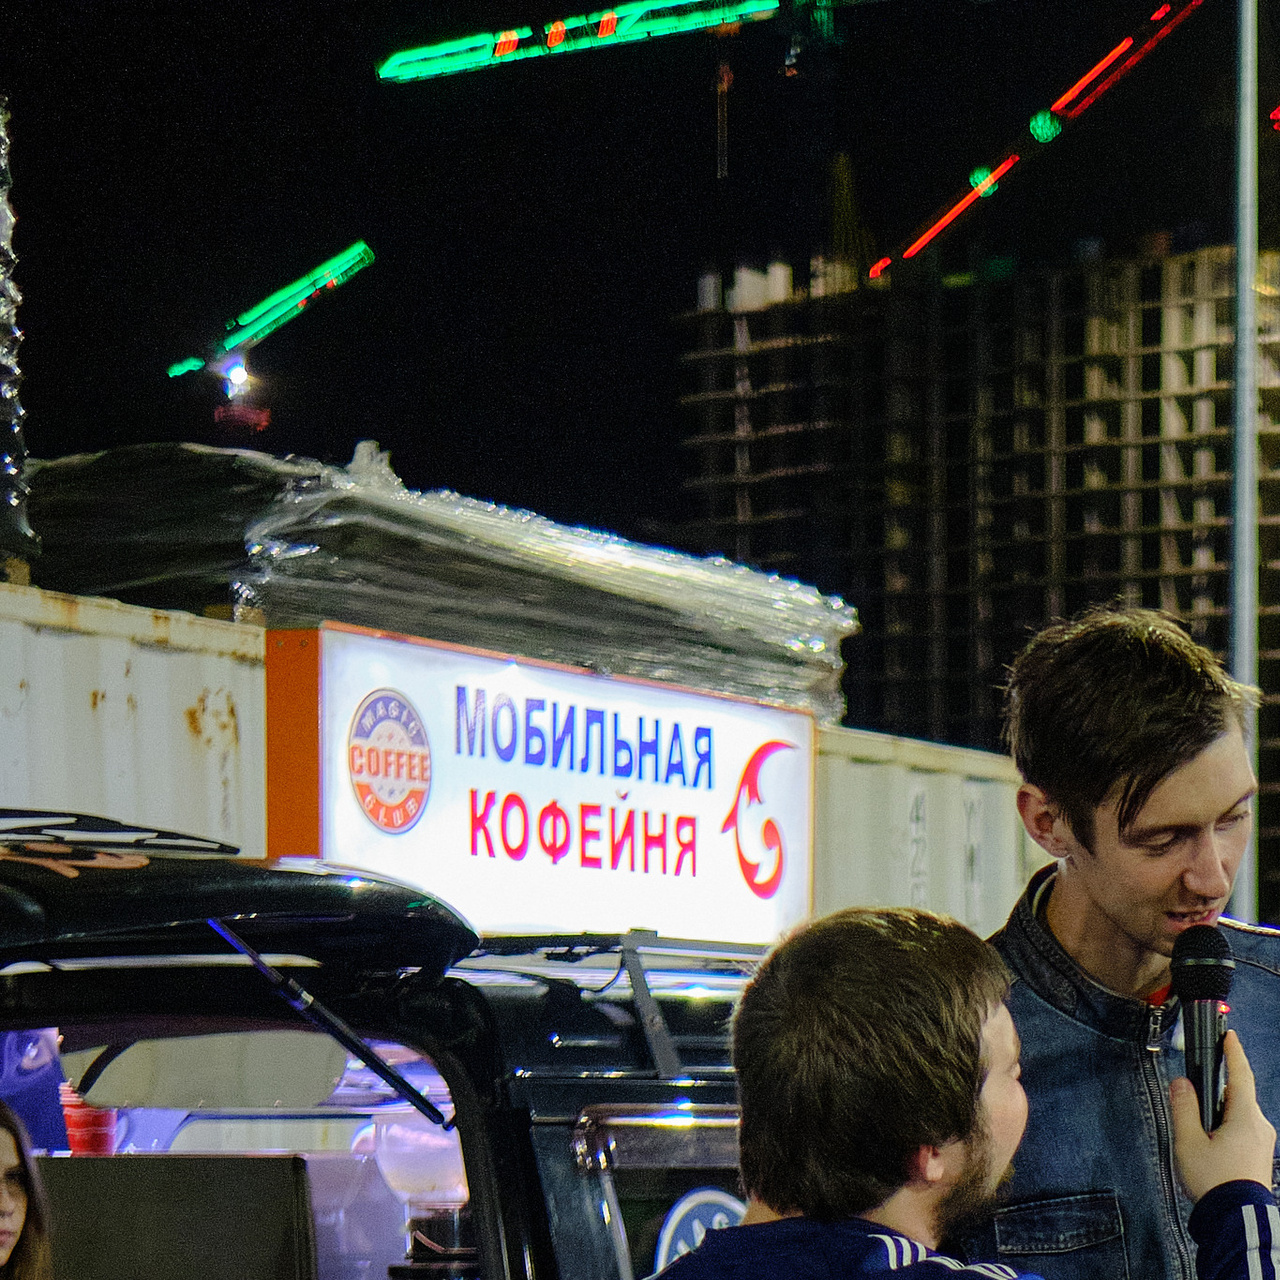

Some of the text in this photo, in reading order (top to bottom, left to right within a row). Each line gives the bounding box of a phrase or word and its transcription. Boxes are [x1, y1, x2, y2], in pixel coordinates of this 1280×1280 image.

[360, 700, 420, 738] MAGIC
[454, 684, 714, 790] МОБИЛЬНАЯ
[350, 745, 430, 782] COFFEE
[469, 788, 698, 878] КОФЕЙНЯ
